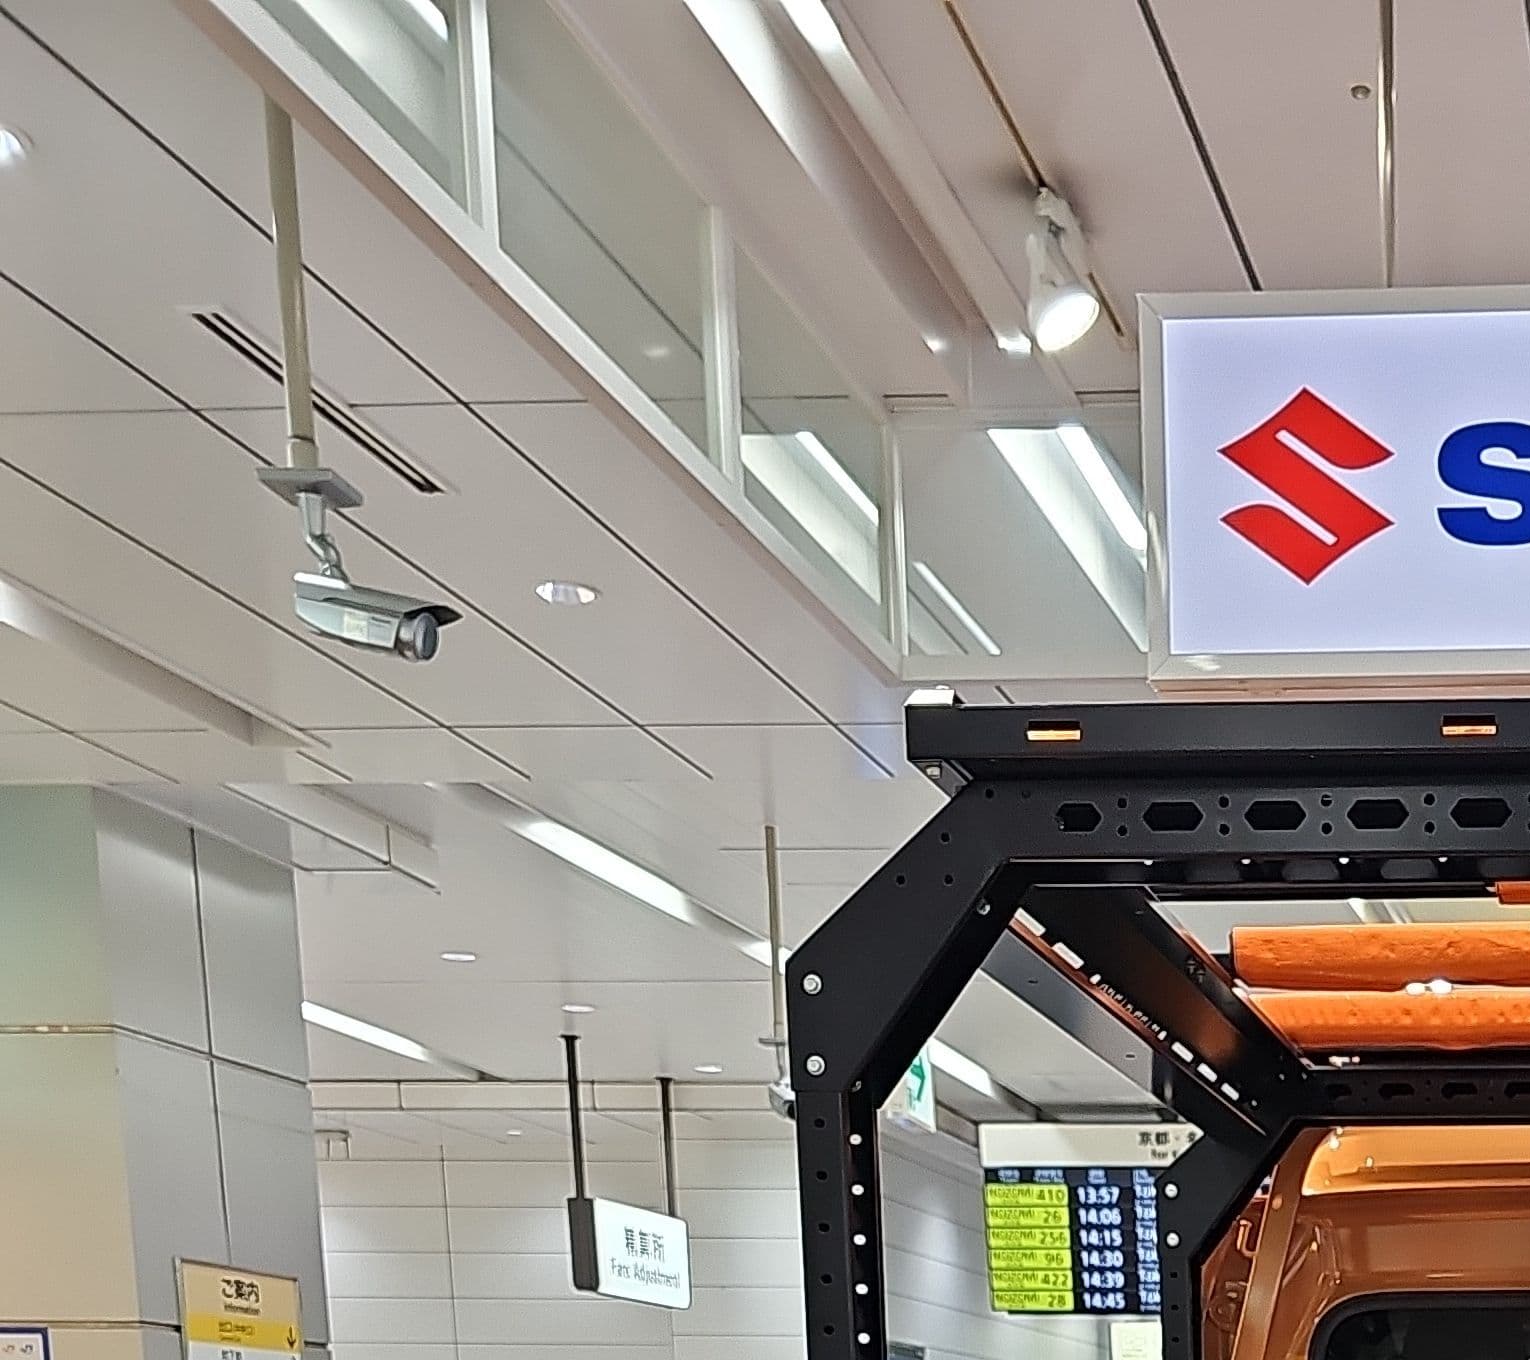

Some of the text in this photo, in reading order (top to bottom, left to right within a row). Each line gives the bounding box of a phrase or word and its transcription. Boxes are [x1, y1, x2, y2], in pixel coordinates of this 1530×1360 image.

[1077, 1186, 1120, 1204] 13:57
[1078, 1208, 1122, 1225] 14:06
[624, 1227, 664, 1262] 精算所
[1079, 1229, 1123, 1246] 14:15
[1080, 1250, 1124, 1267] 14:30
[610, 1257, 680, 1289] Fare Adjustment
[1081, 1271, 1125, 1289] 14:39
[221, 1278, 260, 1303] ご案内
[1083, 1292, 1126, 1309] 14:45
